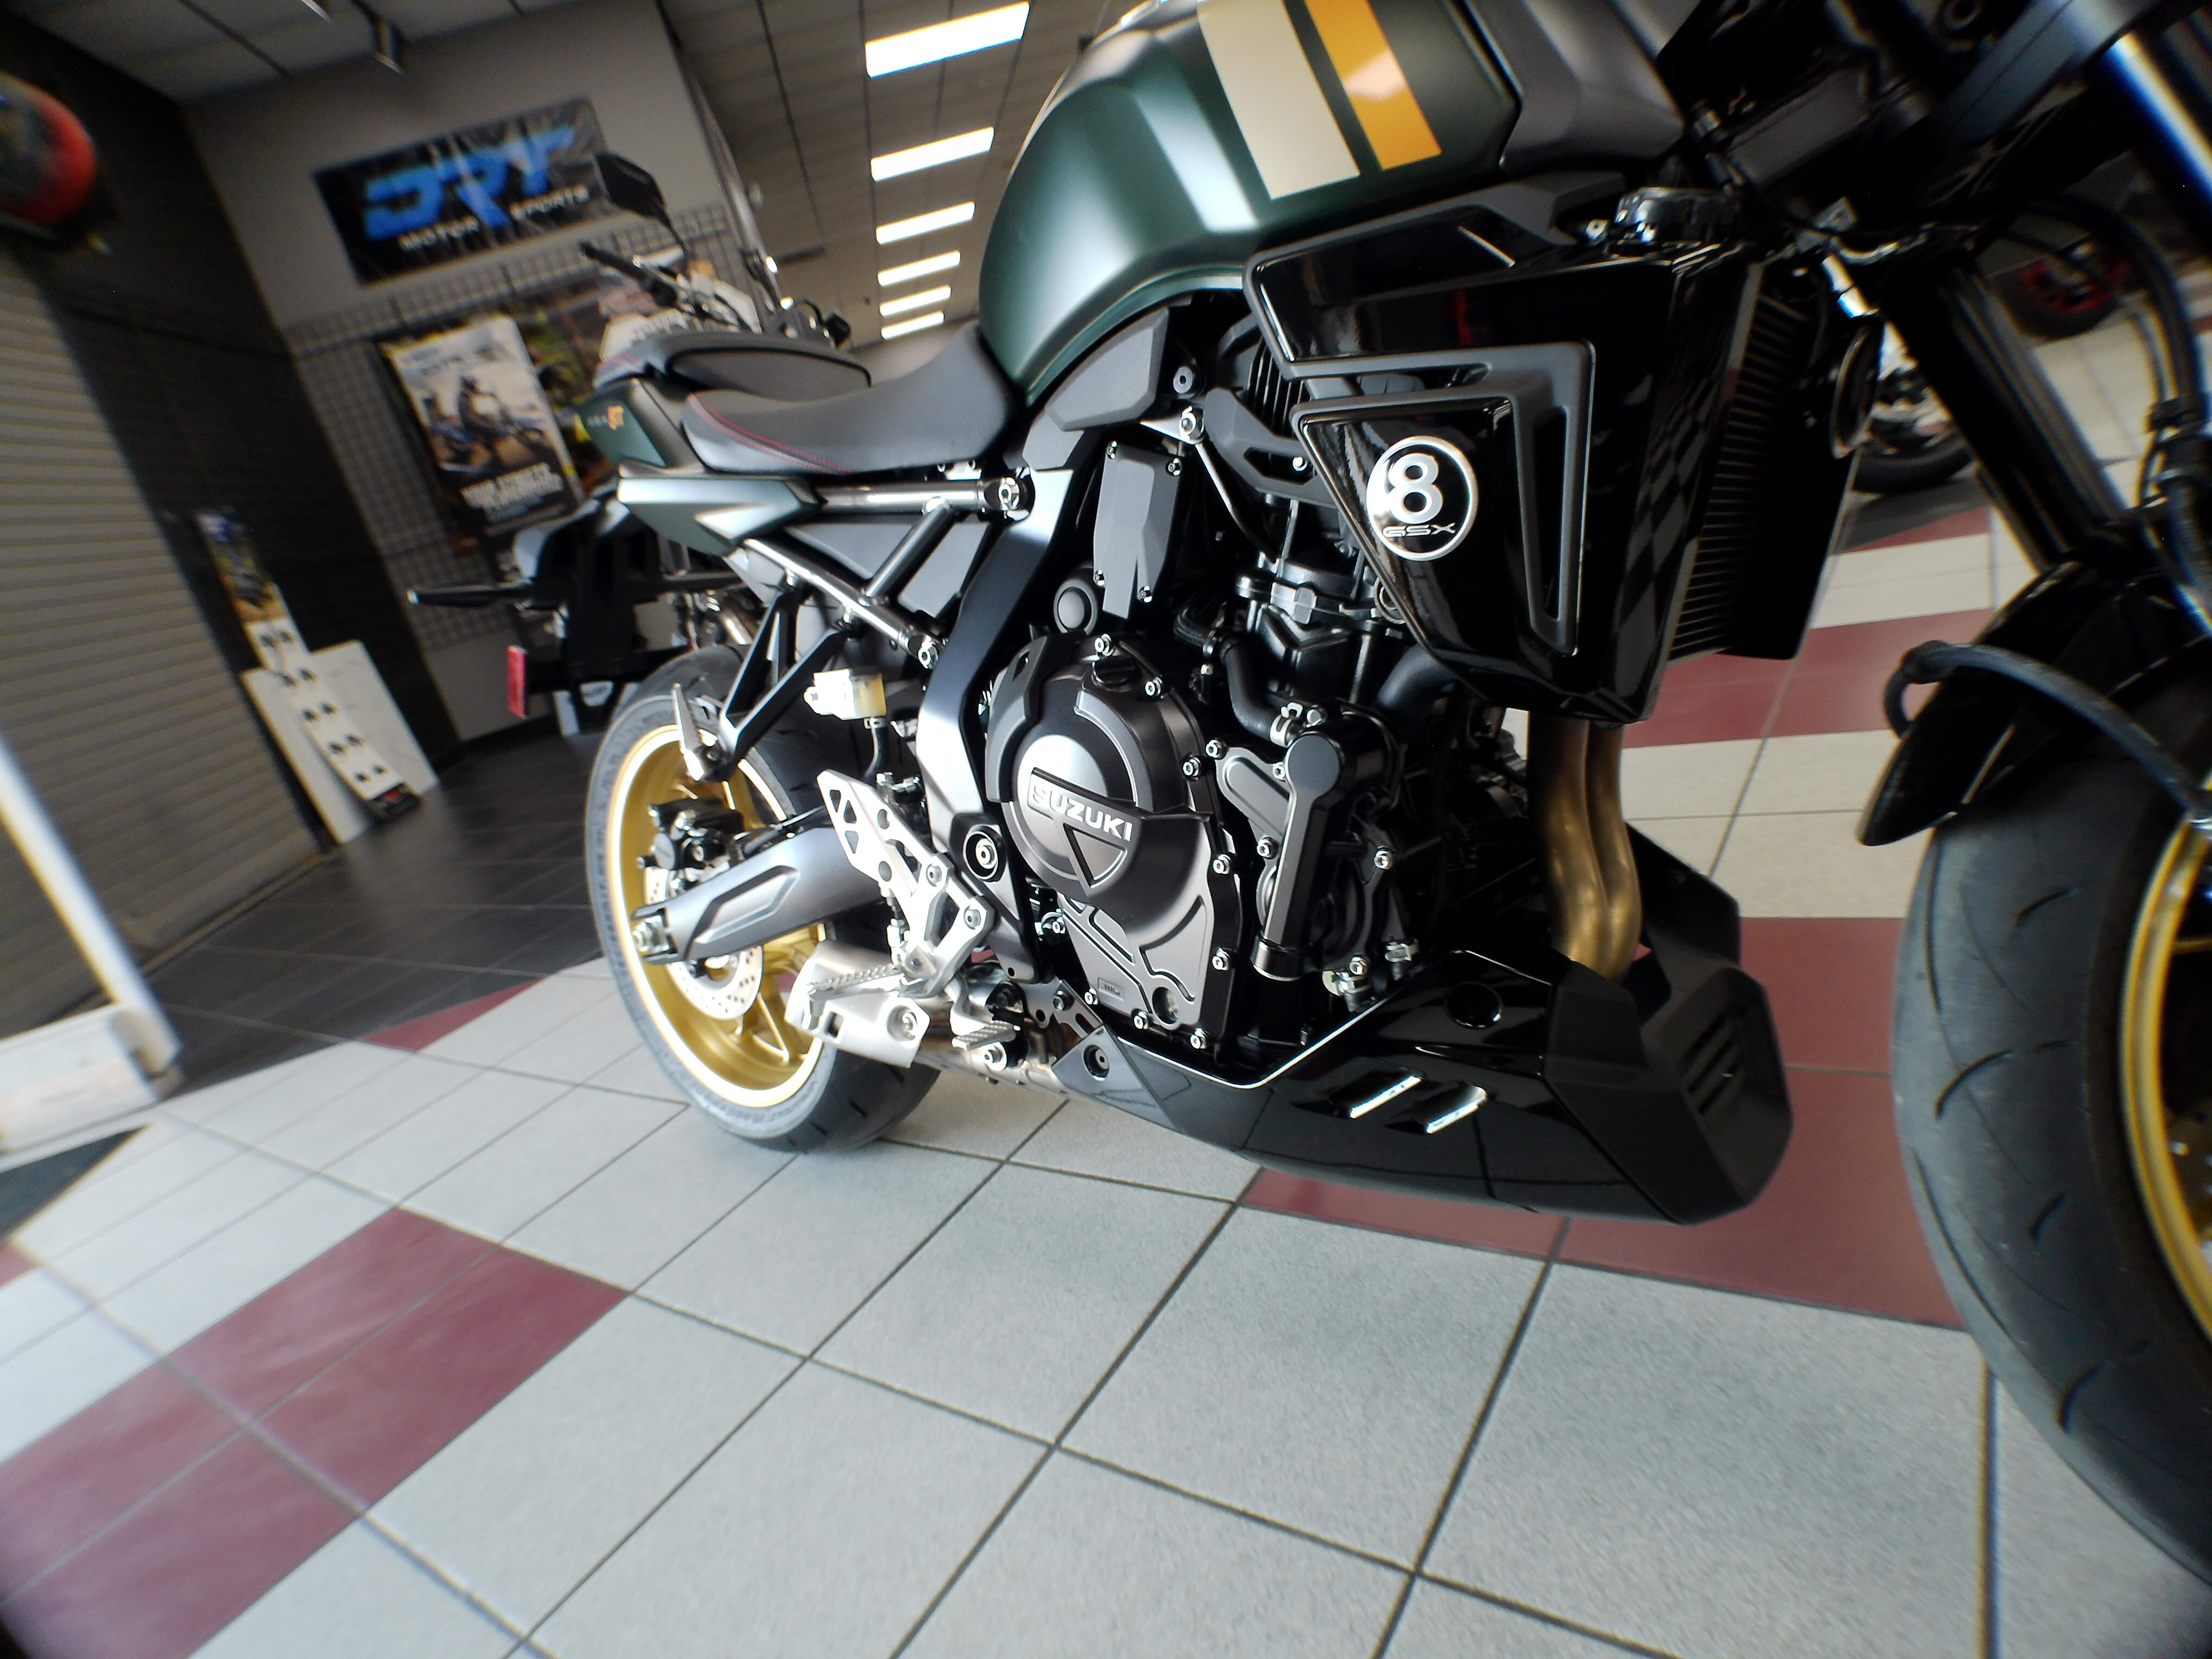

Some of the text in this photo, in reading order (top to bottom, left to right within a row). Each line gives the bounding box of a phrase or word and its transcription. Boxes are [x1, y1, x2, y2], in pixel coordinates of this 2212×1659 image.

[1387, 453, 1443, 524] 8
[1382, 522, 1456, 538] GSX
[1033, 784, 1133, 842] SUZUKI
